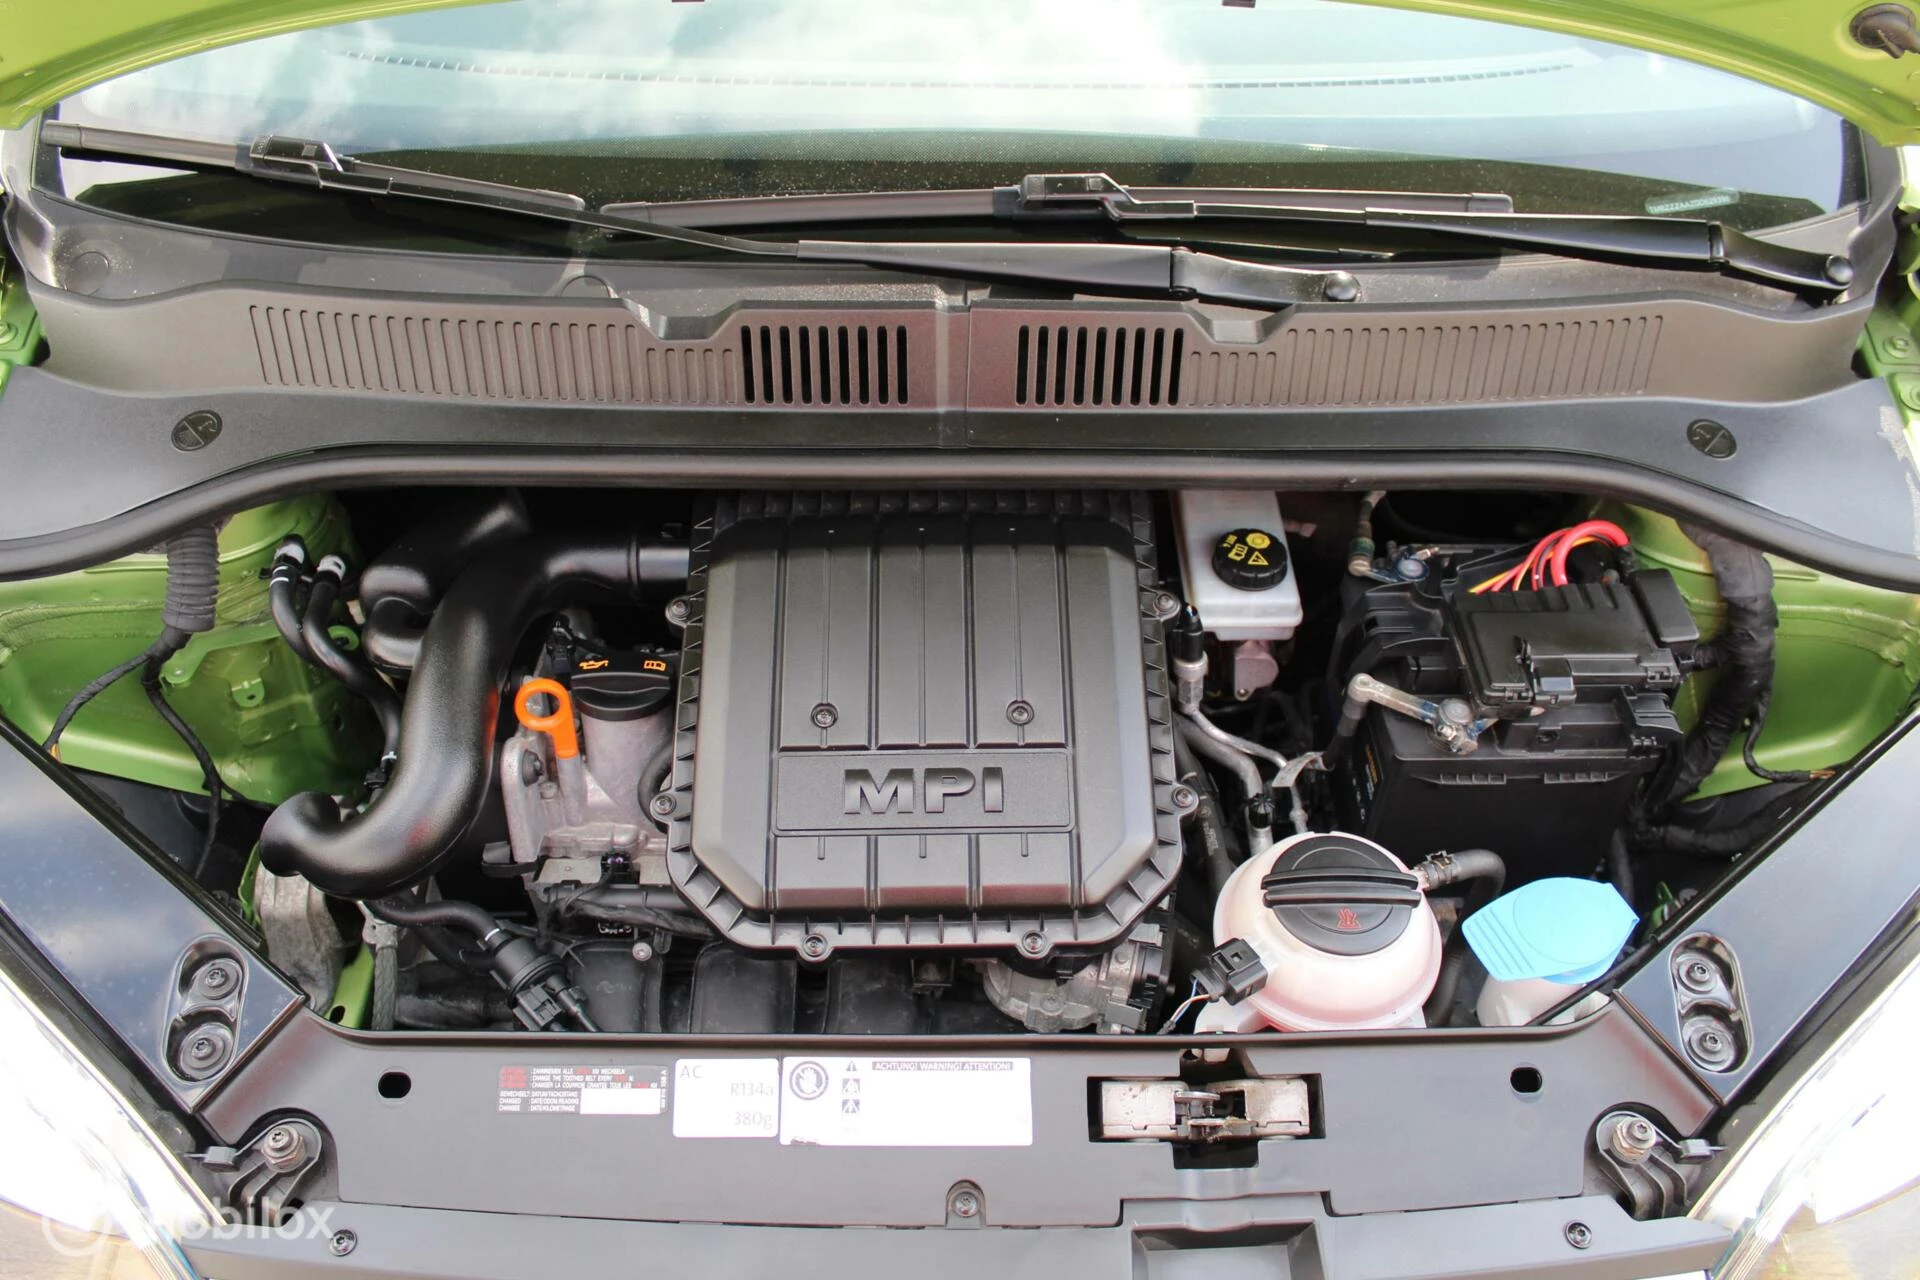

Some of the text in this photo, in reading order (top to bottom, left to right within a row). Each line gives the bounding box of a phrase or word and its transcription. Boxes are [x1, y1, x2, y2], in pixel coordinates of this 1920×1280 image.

[844, 767, 1004, 814] MPI
[680, 1065, 704, 1079] AC
[874, 1062, 1010, 1071] ACHTUNG! WARNING! ATTENTION!
[731, 1082, 774, 1097] R134a
[733, 1111, 773, 1130] 380g
